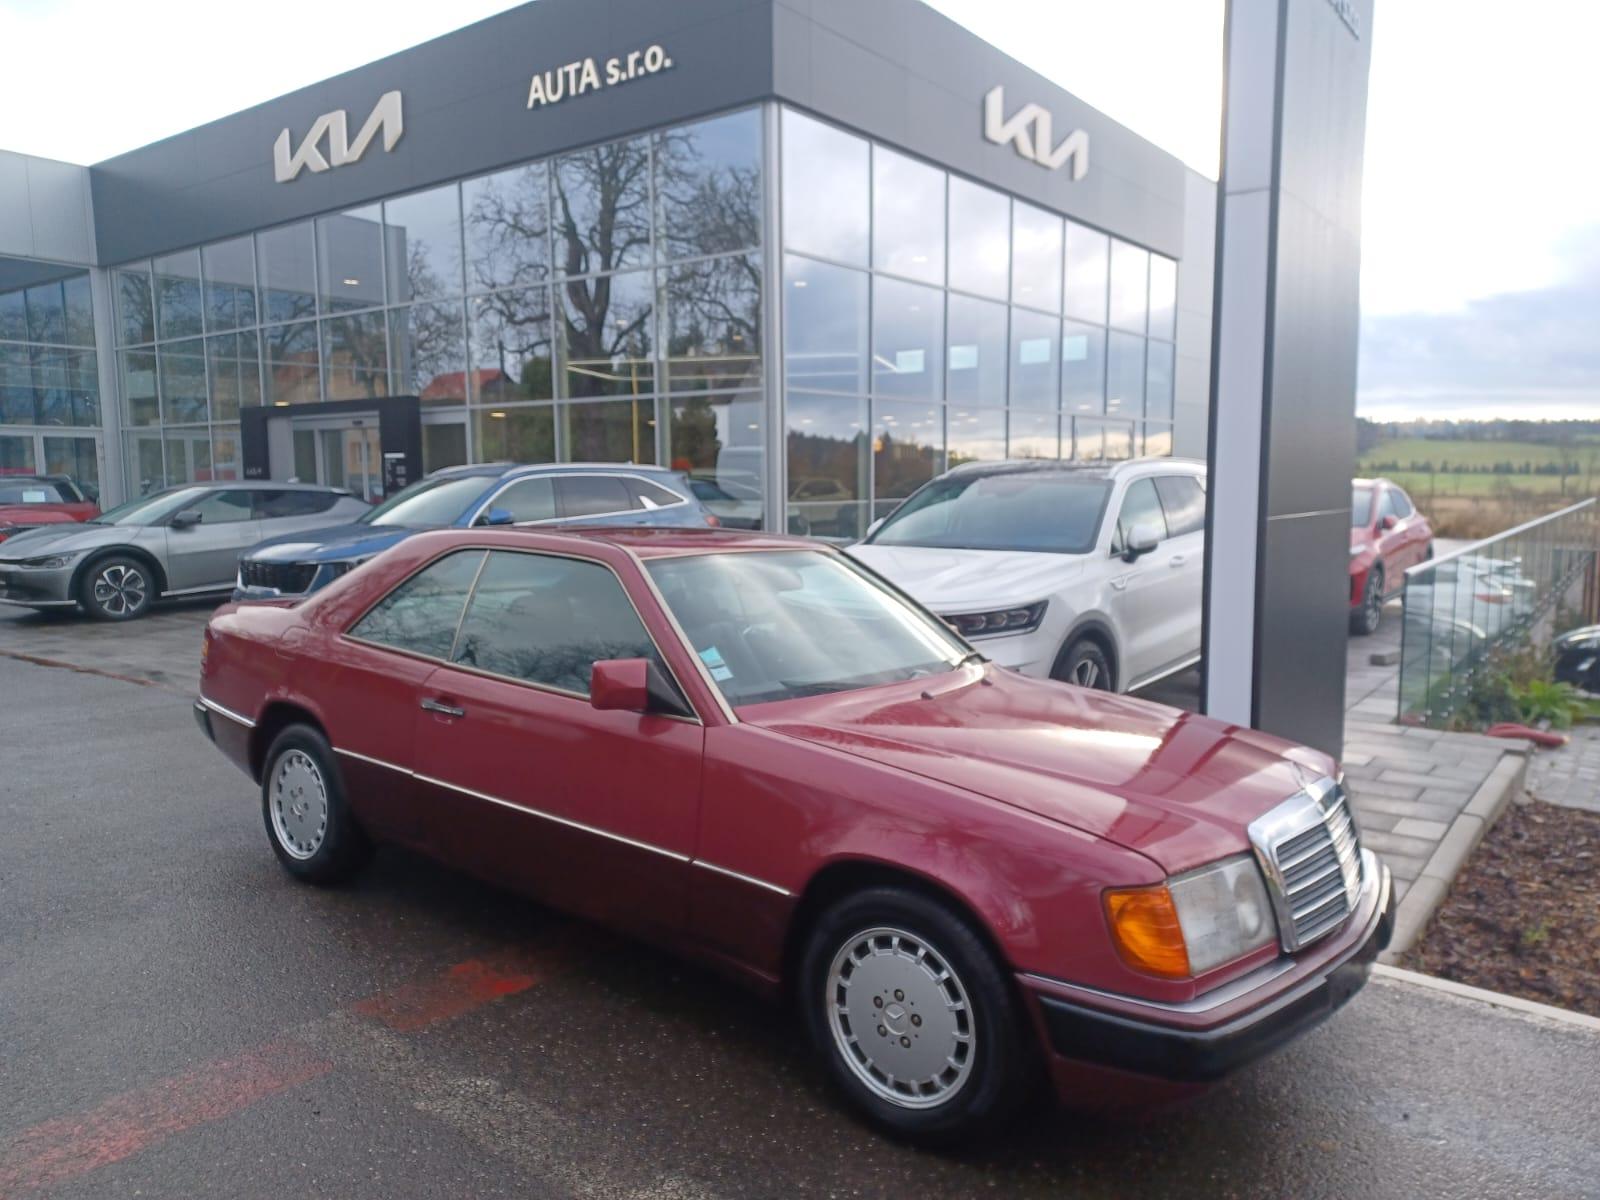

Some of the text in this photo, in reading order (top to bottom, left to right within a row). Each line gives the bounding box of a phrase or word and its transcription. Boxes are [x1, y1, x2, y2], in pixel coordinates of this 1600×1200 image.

[526, 45, 673, 109] AUTA s.r.o.
[273, 90, 403, 183] KIA
[984, 85, 1089, 180] KIA
